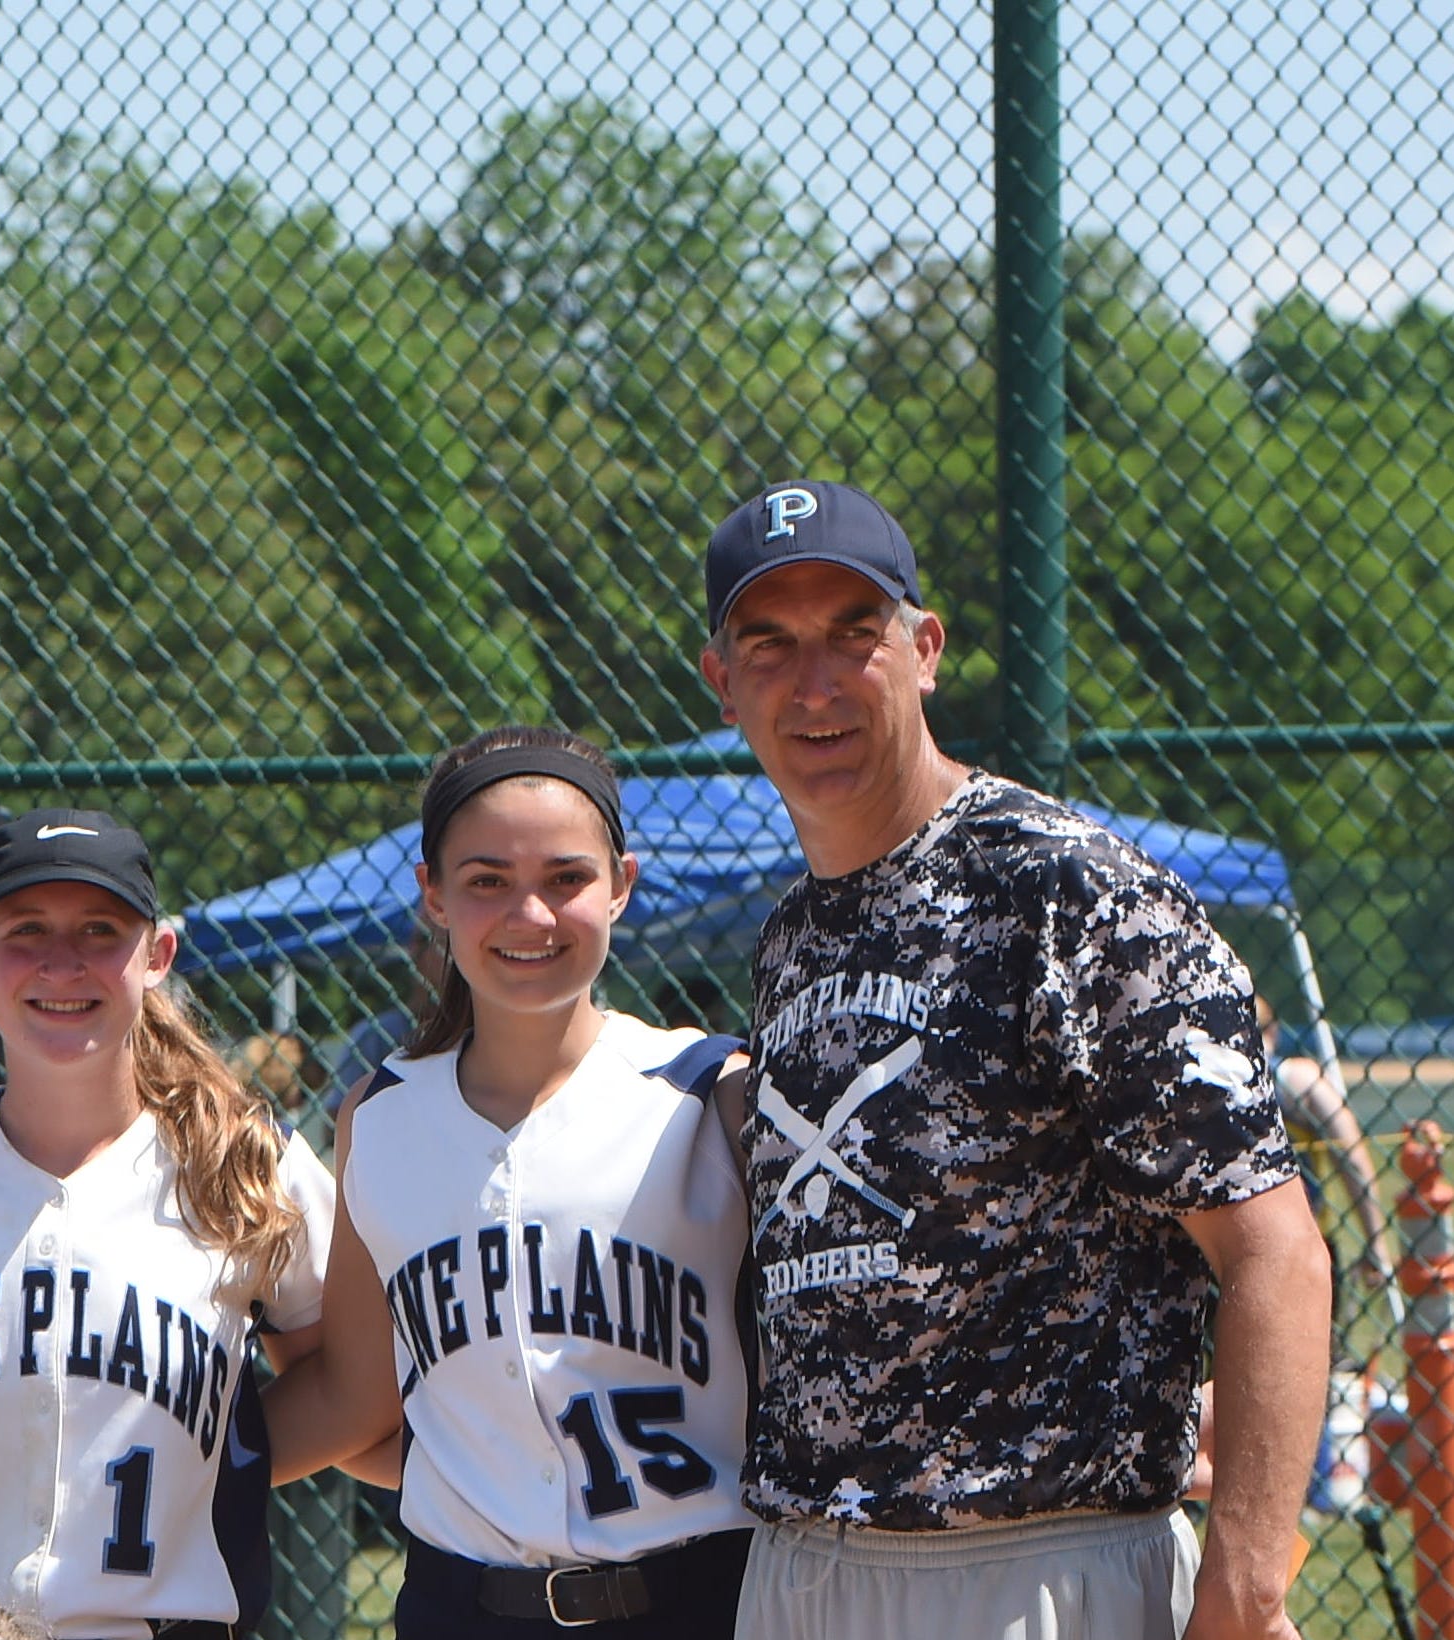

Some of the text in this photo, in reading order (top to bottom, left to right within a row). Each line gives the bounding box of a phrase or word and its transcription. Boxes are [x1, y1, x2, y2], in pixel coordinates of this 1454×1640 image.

[764, 488, 818, 544] P
[757, 970, 931, 1074] PINE PLAINS
[19, 1266, 229, 1462] PLAINS
[477, 1222, 711, 1388] PLAINS
[100, 1444, 156, 1577] 1
[555, 1384, 718, 1521] 15
